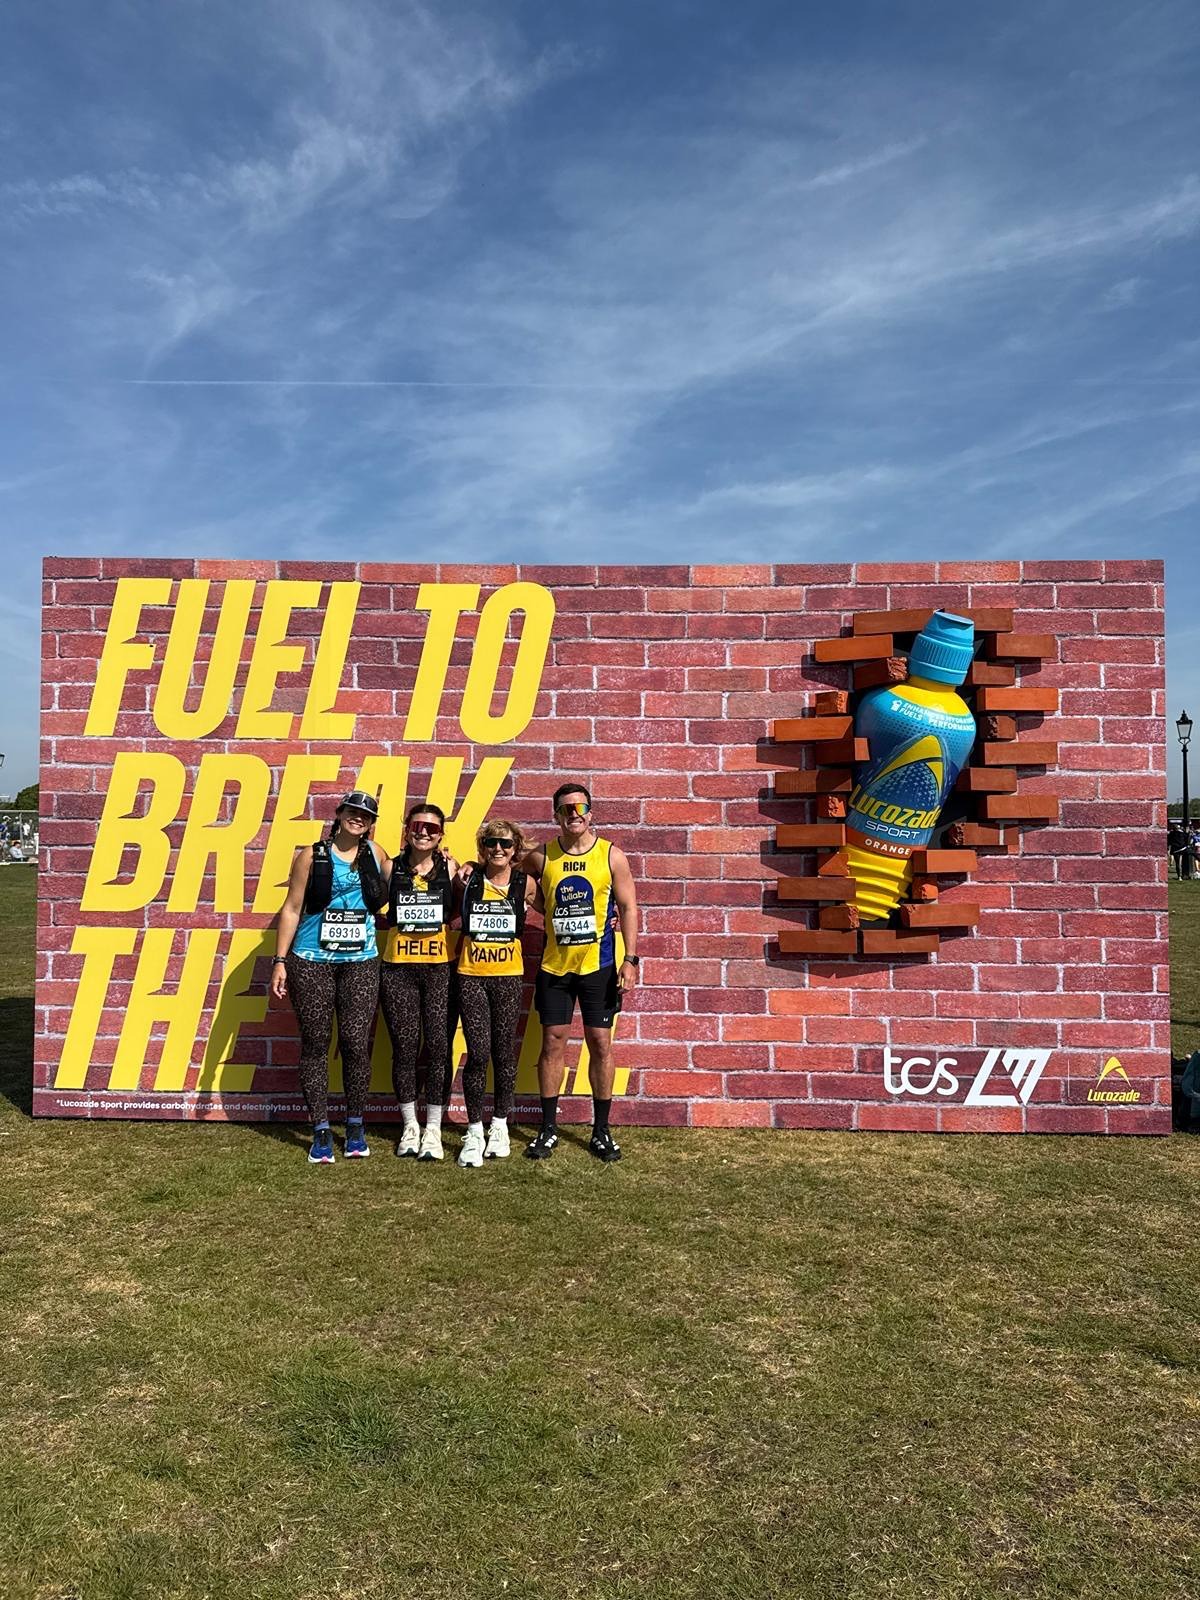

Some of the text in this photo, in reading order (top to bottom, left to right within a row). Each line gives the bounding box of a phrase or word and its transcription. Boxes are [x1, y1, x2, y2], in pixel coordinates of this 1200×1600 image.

[83, 577, 556, 745] FUEL TO
[898, 707, 923, 721] FUELS
[865, 820, 920, 839] SPORT
[865, 838, 911, 855] ORANGE
[563, 861, 586, 872] RICH
[560, 885, 574, 894] the
[399, 893, 416, 904] tcs
[561, 890, 588, 902] lullaby
[472, 902, 489, 913] tcs
[555, 906, 569, 917] tcs
[325, 910, 343, 922] tcs
[404, 908, 436, 920] 65284
[476, 917, 509, 929] 74806
[559, 920, 590, 932] 74344
[329, 927, 361, 938] 69319
[53, 927, 278, 1092] THE
[884, 1046, 959, 1095] tcs
[1087, 1088, 1140, 1103] Lucozade
[100, 1101, 123, 1110] Sport
[124, 1100, 160, 1110] provides
[161, 1101, 223, 1111] carbohydrates
[242, 1103, 291, 1113] electrolytes
[292, 1103, 301, 1111] to
[383, 1104, 399, 1112] and
